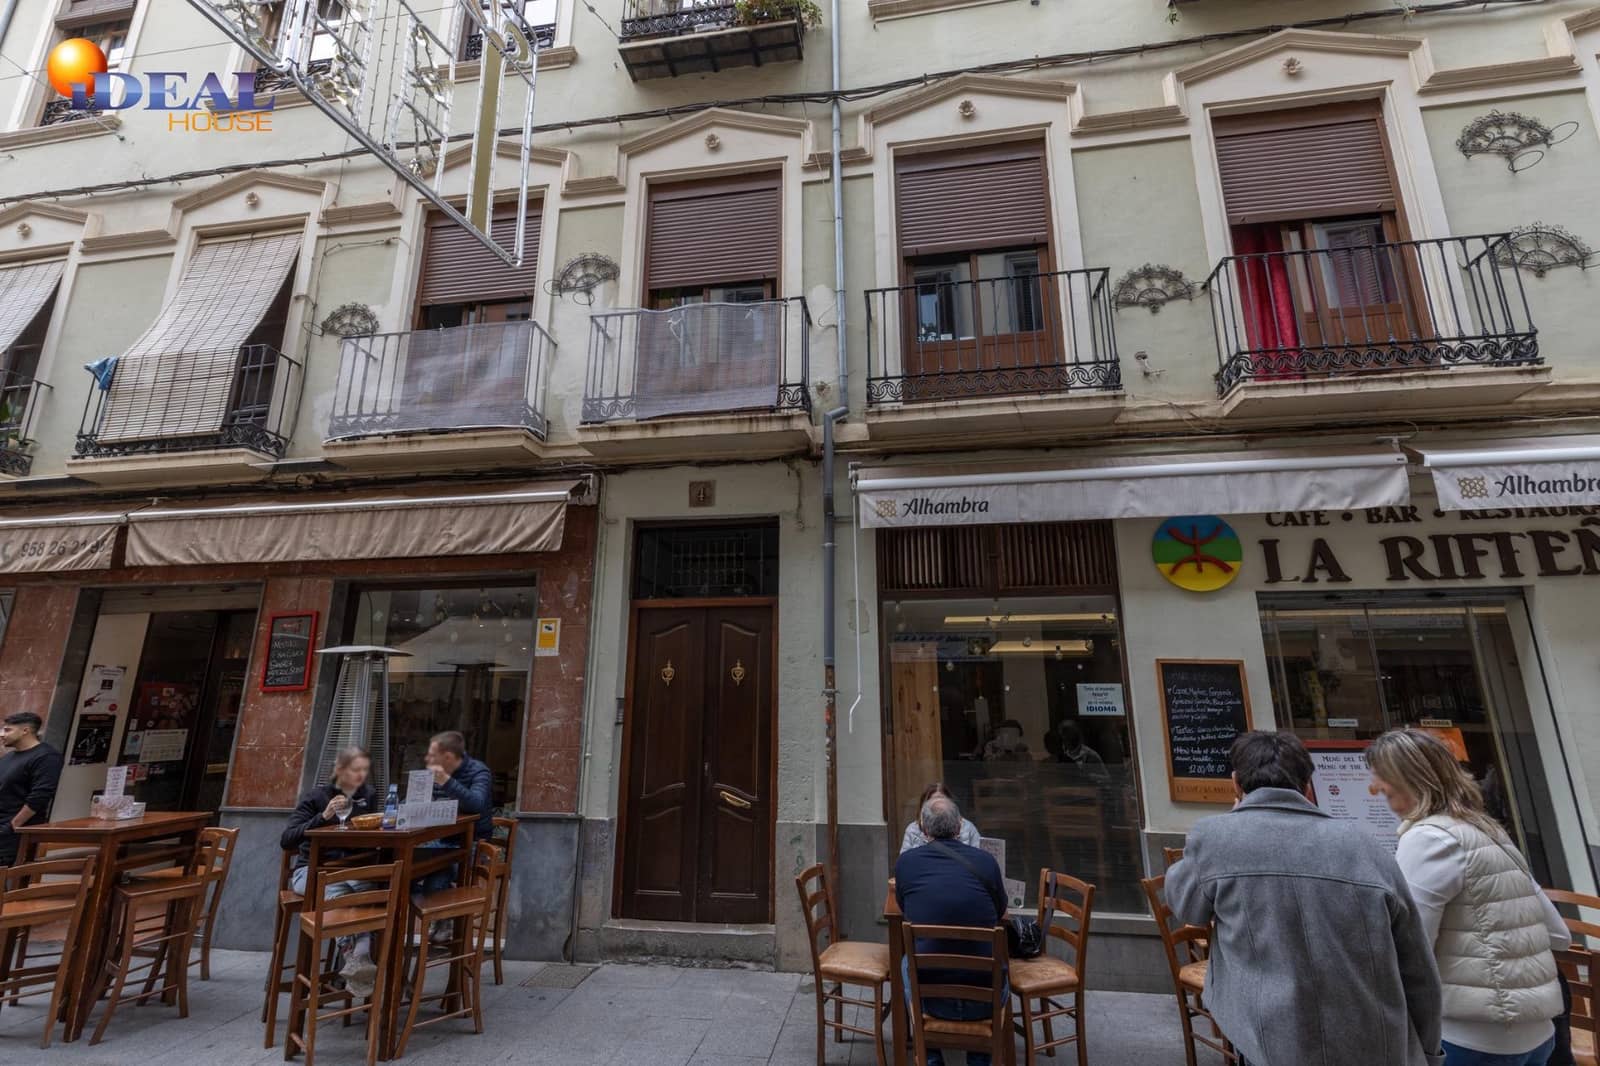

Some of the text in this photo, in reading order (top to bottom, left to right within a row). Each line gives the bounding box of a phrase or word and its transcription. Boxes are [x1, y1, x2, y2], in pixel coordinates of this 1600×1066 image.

[1495, 472, 1600, 497] Alhambr
[902, 496, 989, 518] Alhambra
[1366, 504, 1423, 524] BAR
[21, 541, 46, 558] 958
[48, 540, 66, 556] 26
[1258, 538, 1353, 584] LA
